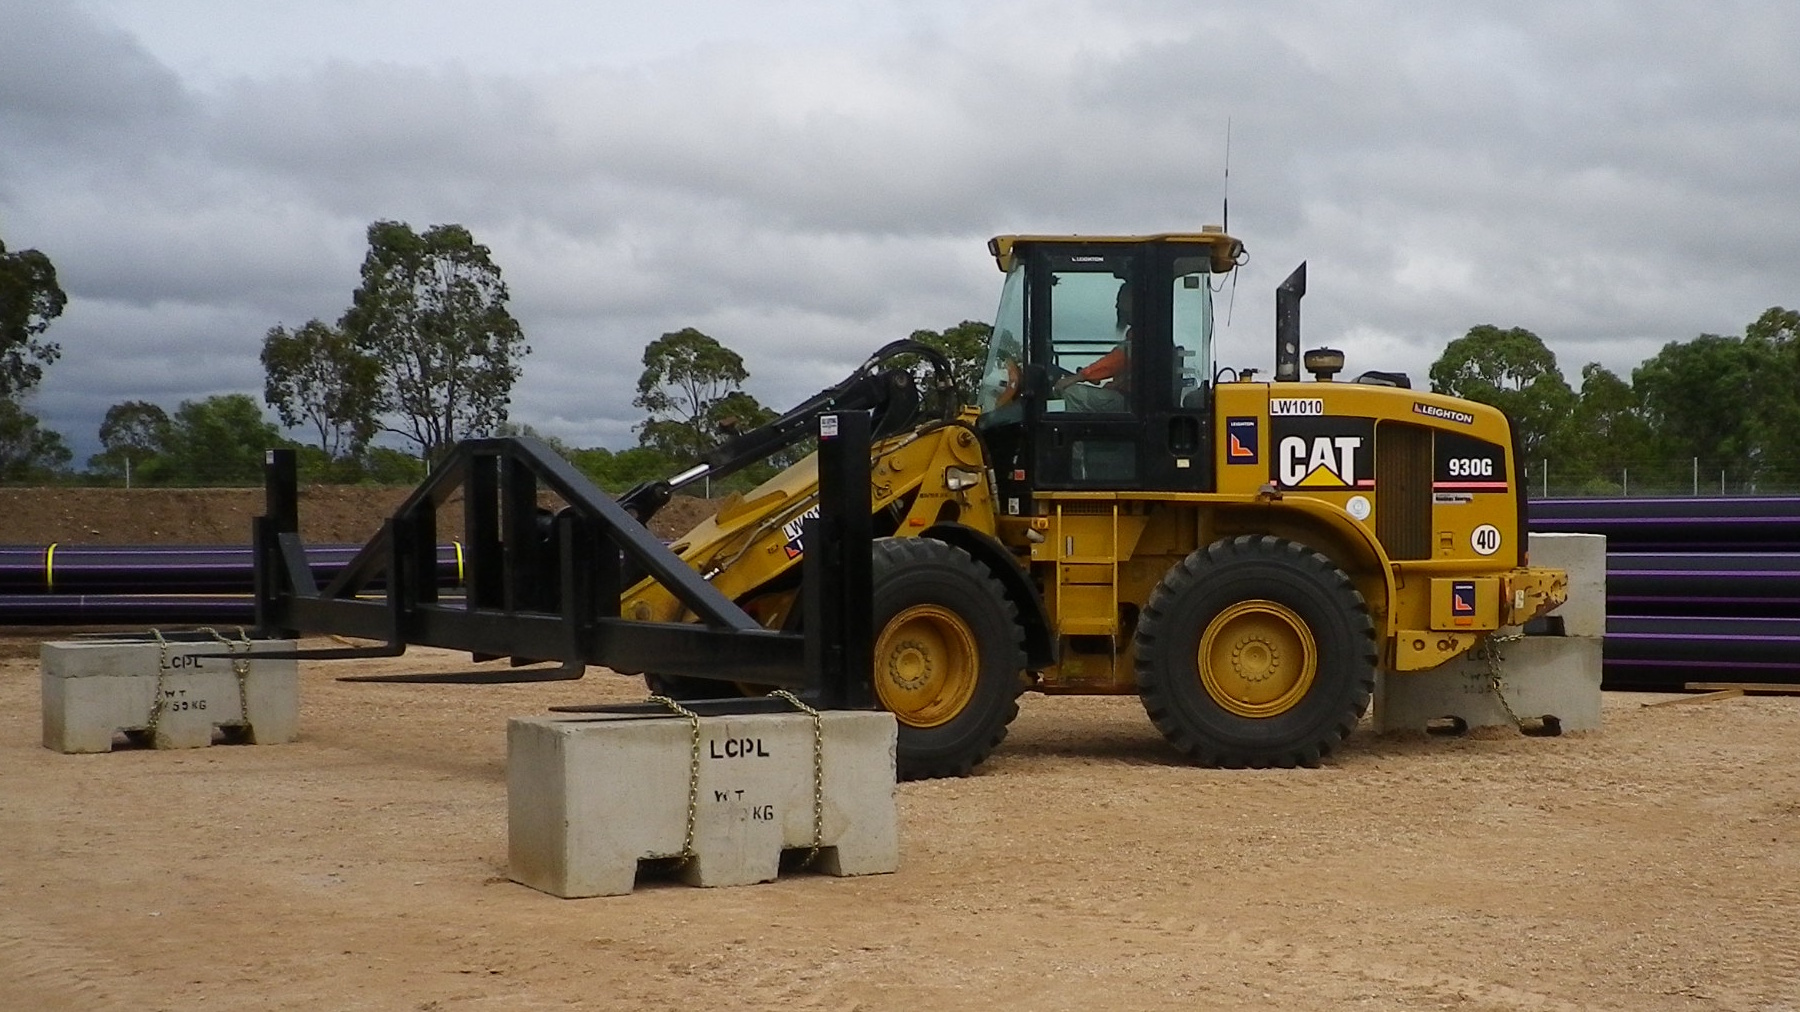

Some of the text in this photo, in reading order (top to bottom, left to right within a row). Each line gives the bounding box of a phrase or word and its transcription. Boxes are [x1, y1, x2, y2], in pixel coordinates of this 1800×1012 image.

[1271, 400, 1322, 414] LW1010
[1422, 405, 1472, 423] LEIGHTON
[1280, 436, 1361, 487] CAT
[1449, 458, 1493, 477] 930G
[1477, 530, 1496, 549] 40
[710, 738, 770, 759] LCPL
